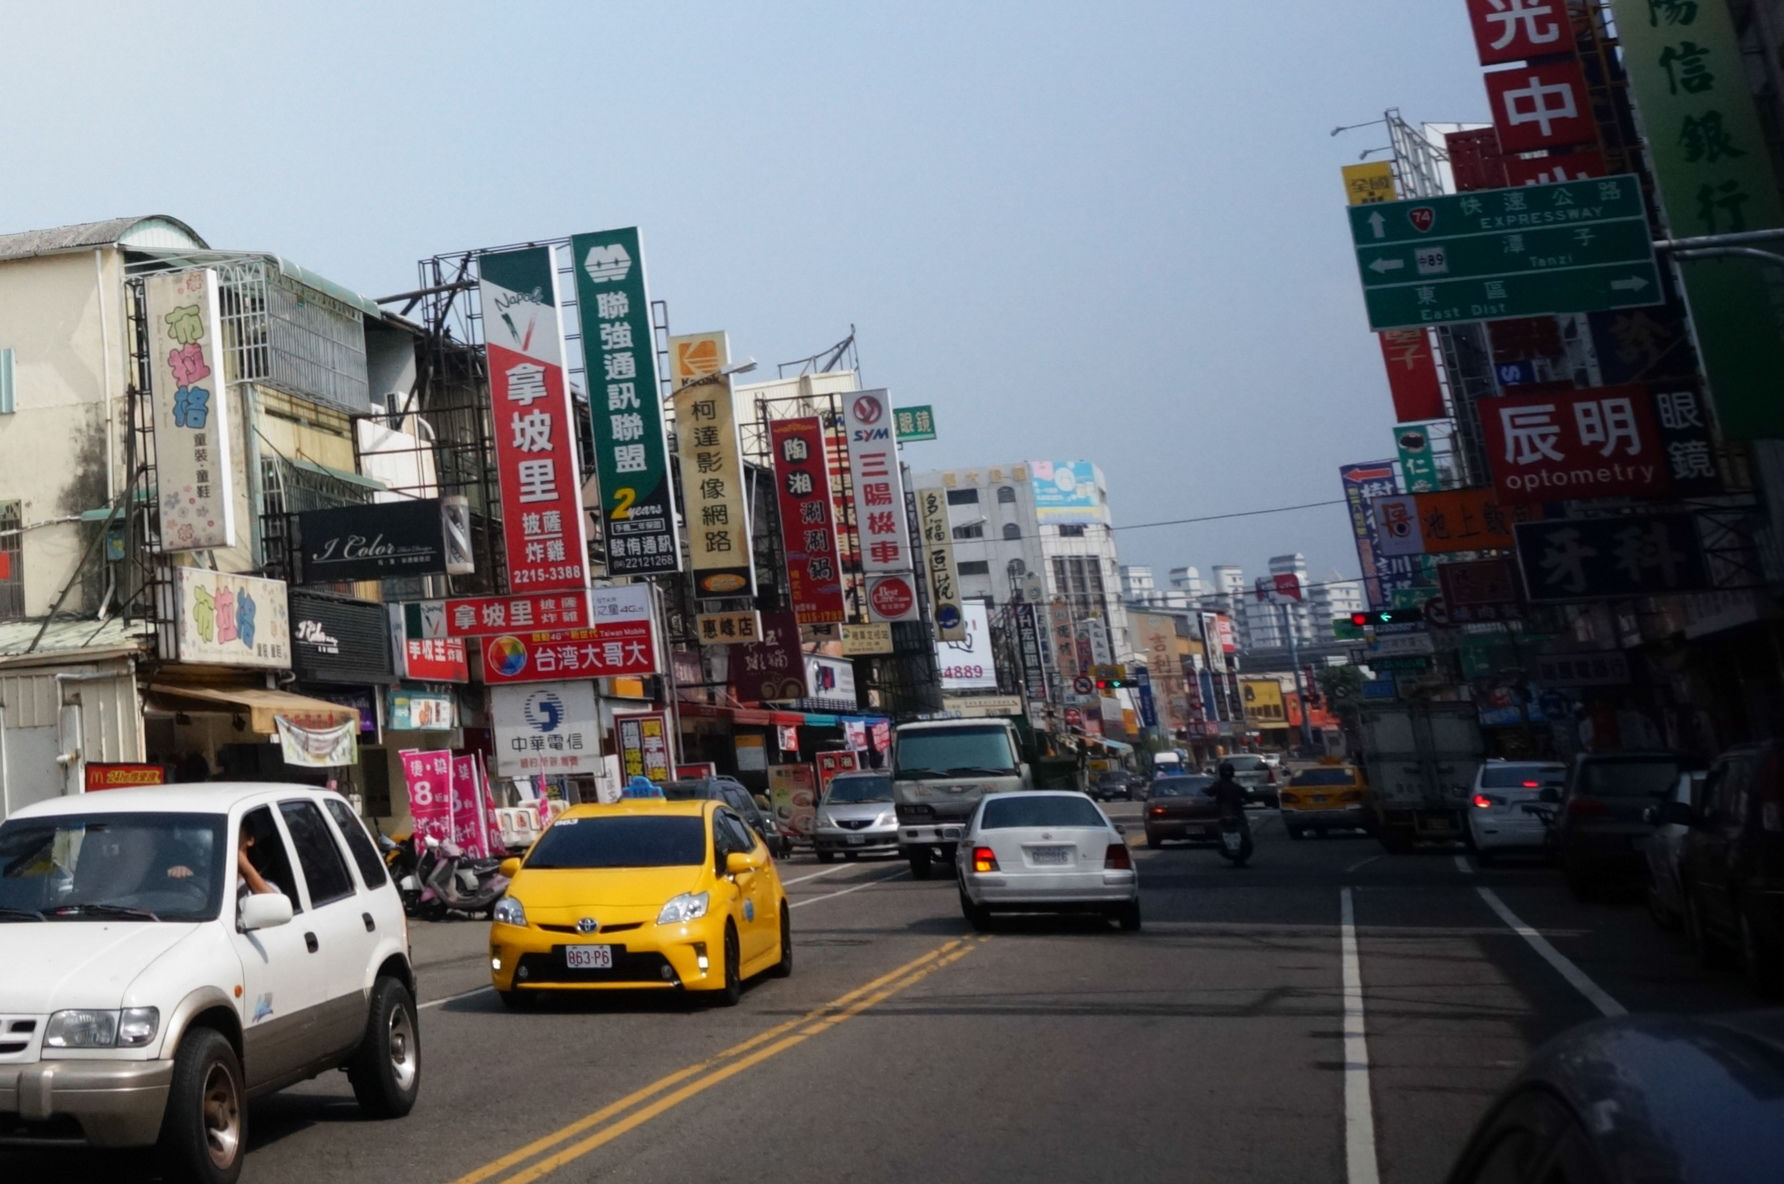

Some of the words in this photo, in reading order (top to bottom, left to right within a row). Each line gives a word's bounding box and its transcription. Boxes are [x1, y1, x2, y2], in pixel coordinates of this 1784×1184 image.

[1459, 181, 1623, 215] 快速公路
[1411, 209, 1431, 222] 74
[1479, 206, 1604, 230] EXPRESSWAY
[1415, 280, 1508, 306] 東區
[1421, 307, 1462, 321] East
[596, 291, 648, 474] 聯強通訊聯盟
[504, 362, 561, 505] 拿坡里
[852, 428, 890, 443] SYM
[895, 410, 932, 434] 眼鏡
[1497, 394, 1644, 467] 辰明
[1655, 388, 1716, 482] 眼鏡
[691, 399, 733, 554] 柯達影像網路
[1504, 461, 1656, 494] optometry
[609, 486, 636, 520] 2
[859, 451, 900, 564] 三陽機車
[343, 533, 396, 560] Color
[514, 565, 581, 584] 2215-3388
[453, 599, 535, 629] 拿坡里
[943, 664, 984, 679] 4889
[511, 733, 584, 753] 中華電信
[413, 780, 433, 806] 8
